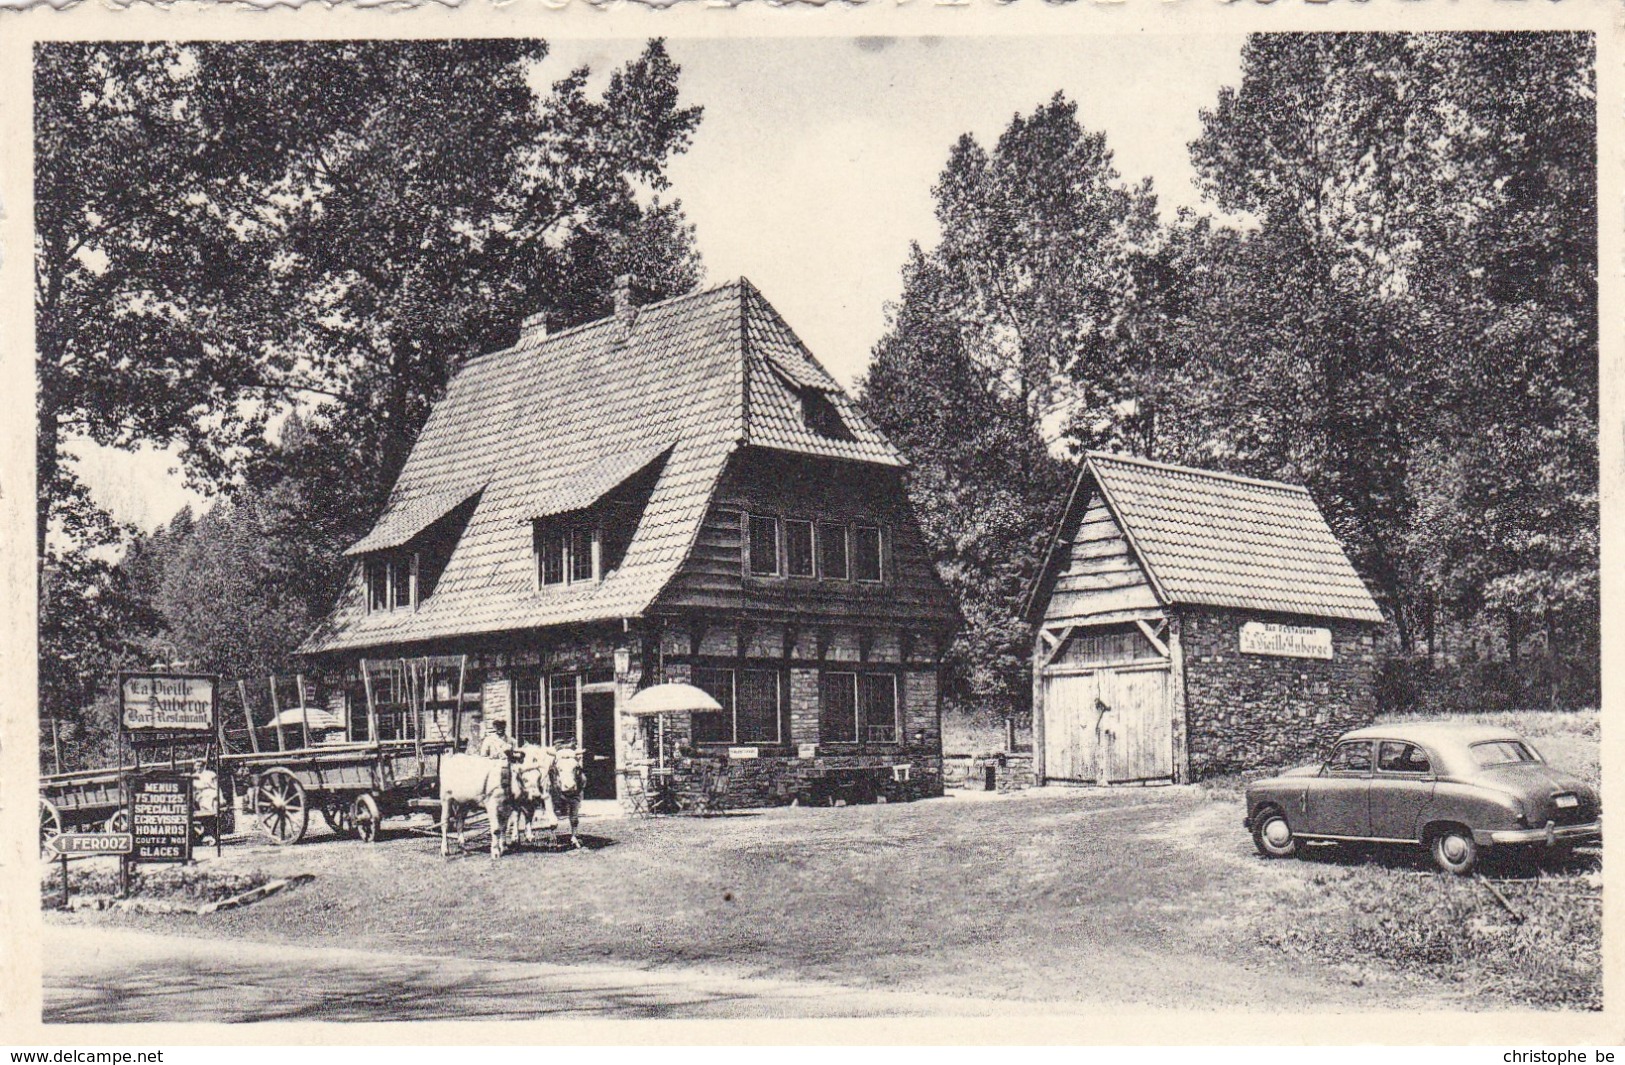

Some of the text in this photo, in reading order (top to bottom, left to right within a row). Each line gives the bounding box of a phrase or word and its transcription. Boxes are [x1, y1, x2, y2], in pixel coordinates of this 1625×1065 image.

[1285, 635, 1328, 655] Auberge
[131, 680, 193, 696] La Vieille
[149, 696, 209, 713] Auberge
[144, 782, 179, 793] MENUS
[134, 804, 187, 814] SPECIALITE
[134, 814, 188, 825] ECREVISSES
[135, 825, 185, 835] HOMARDS
[61, 837, 128, 850] 1 FEROOZ
[140, 846, 180, 857] GLACES
